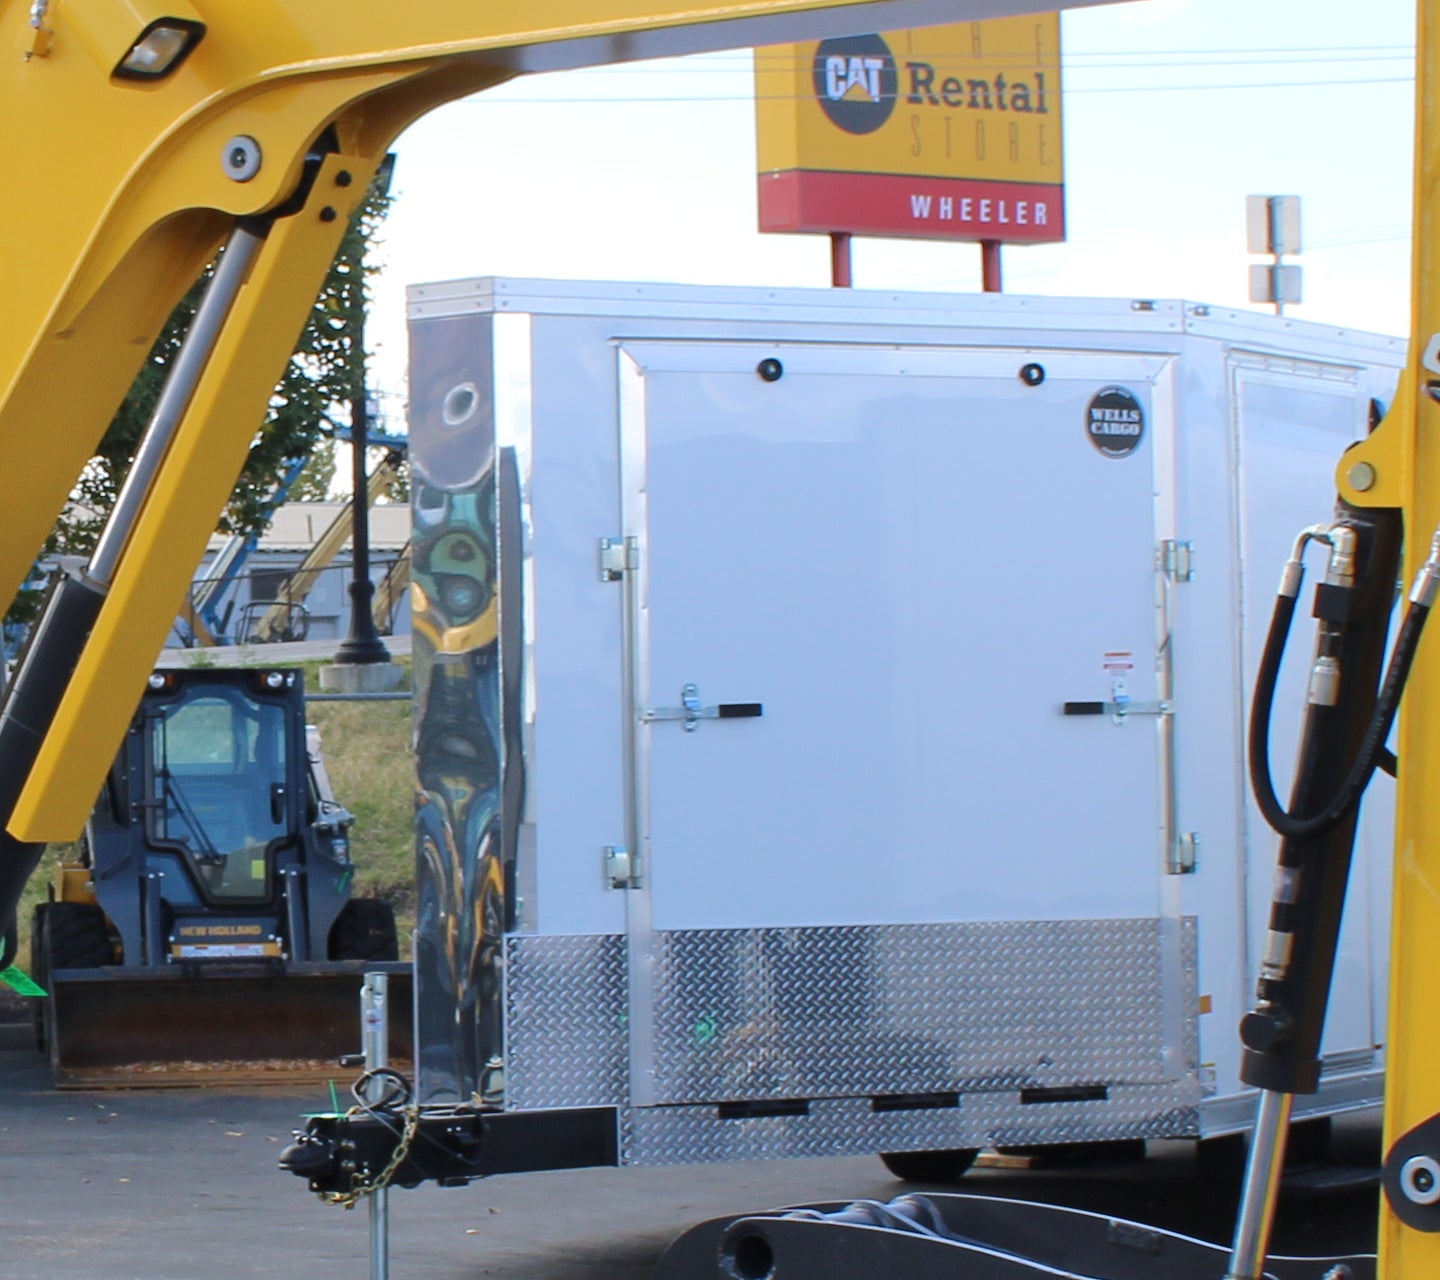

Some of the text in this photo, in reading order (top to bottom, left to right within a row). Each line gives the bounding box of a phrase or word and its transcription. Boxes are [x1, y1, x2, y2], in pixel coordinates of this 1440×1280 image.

[825, 55, 883, 103] CAT
[906, 61, 1048, 114] Rental
[911, 114, 1048, 166] STORE
[911, 195, 1048, 225] WHEELER
[1090, 408, 1140, 422] WELLS
[1090, 422, 1140, 435] CARGO
[180, 924, 262, 936] NEW HOLLAND
